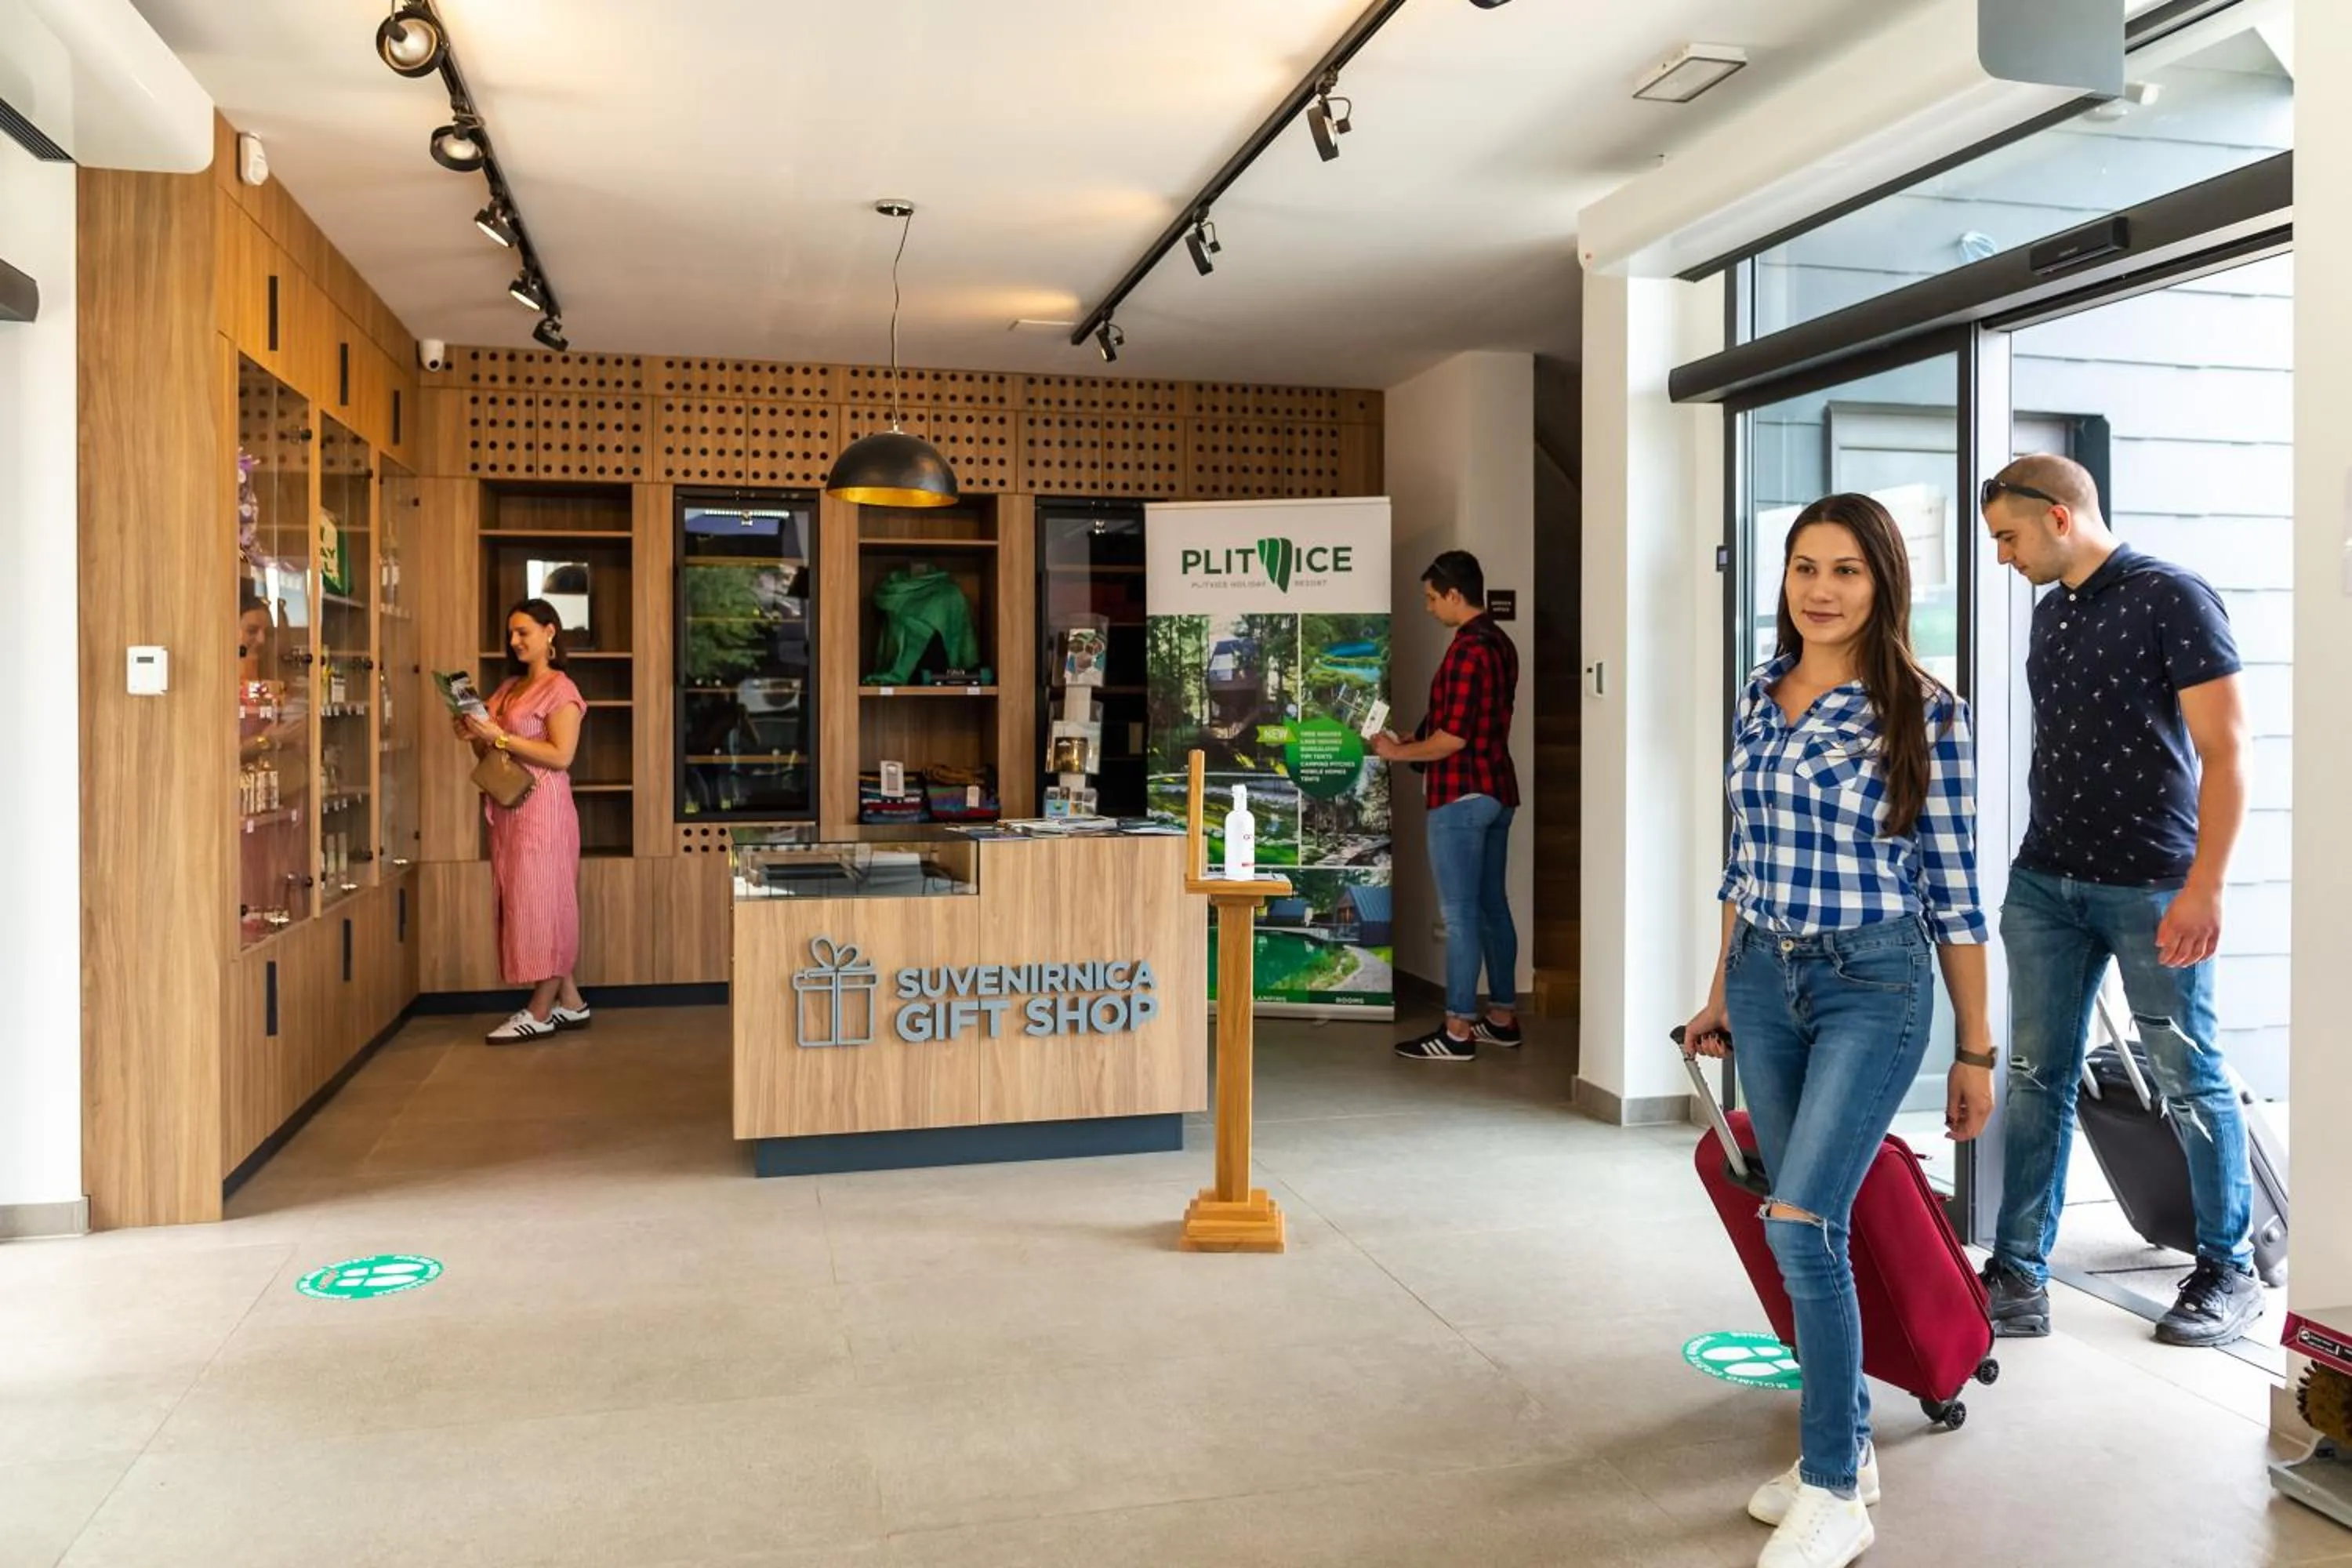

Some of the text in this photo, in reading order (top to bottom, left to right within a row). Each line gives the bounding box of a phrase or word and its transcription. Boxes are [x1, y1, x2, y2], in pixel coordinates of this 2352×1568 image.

[1263, 729, 1288, 739] NEW
[895, 960, 1158, 999] SUVENIRNICA
[896, 993, 1158, 1043] GIFT SHOP
